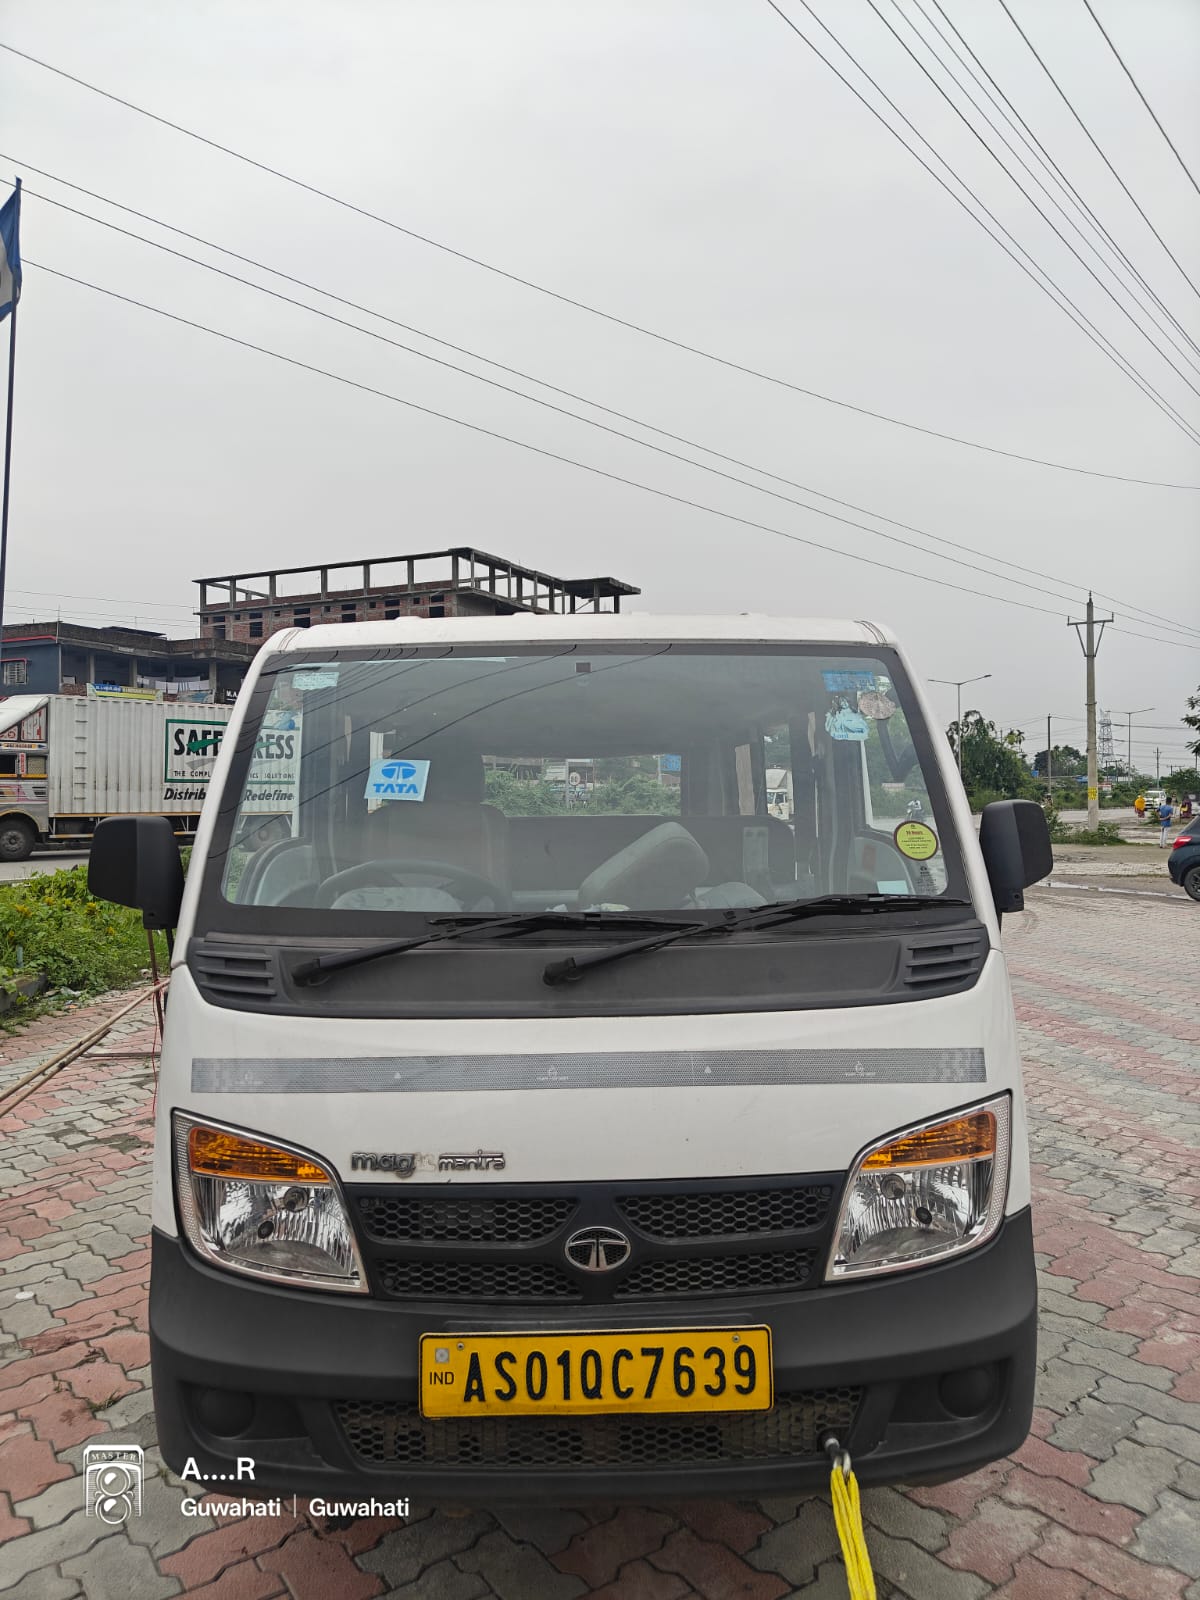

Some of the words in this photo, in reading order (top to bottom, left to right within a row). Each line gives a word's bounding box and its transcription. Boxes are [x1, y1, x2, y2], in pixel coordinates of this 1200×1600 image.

[190, 770, 211, 778] COMPL
[164, 787, 207, 801] Distrib
[373, 783, 418, 794] TATA
[438, 1150, 506, 1171] mantra
[429, 1371, 455, 1385] IND
[463, 1345, 757, 1402] AS01QC7639
